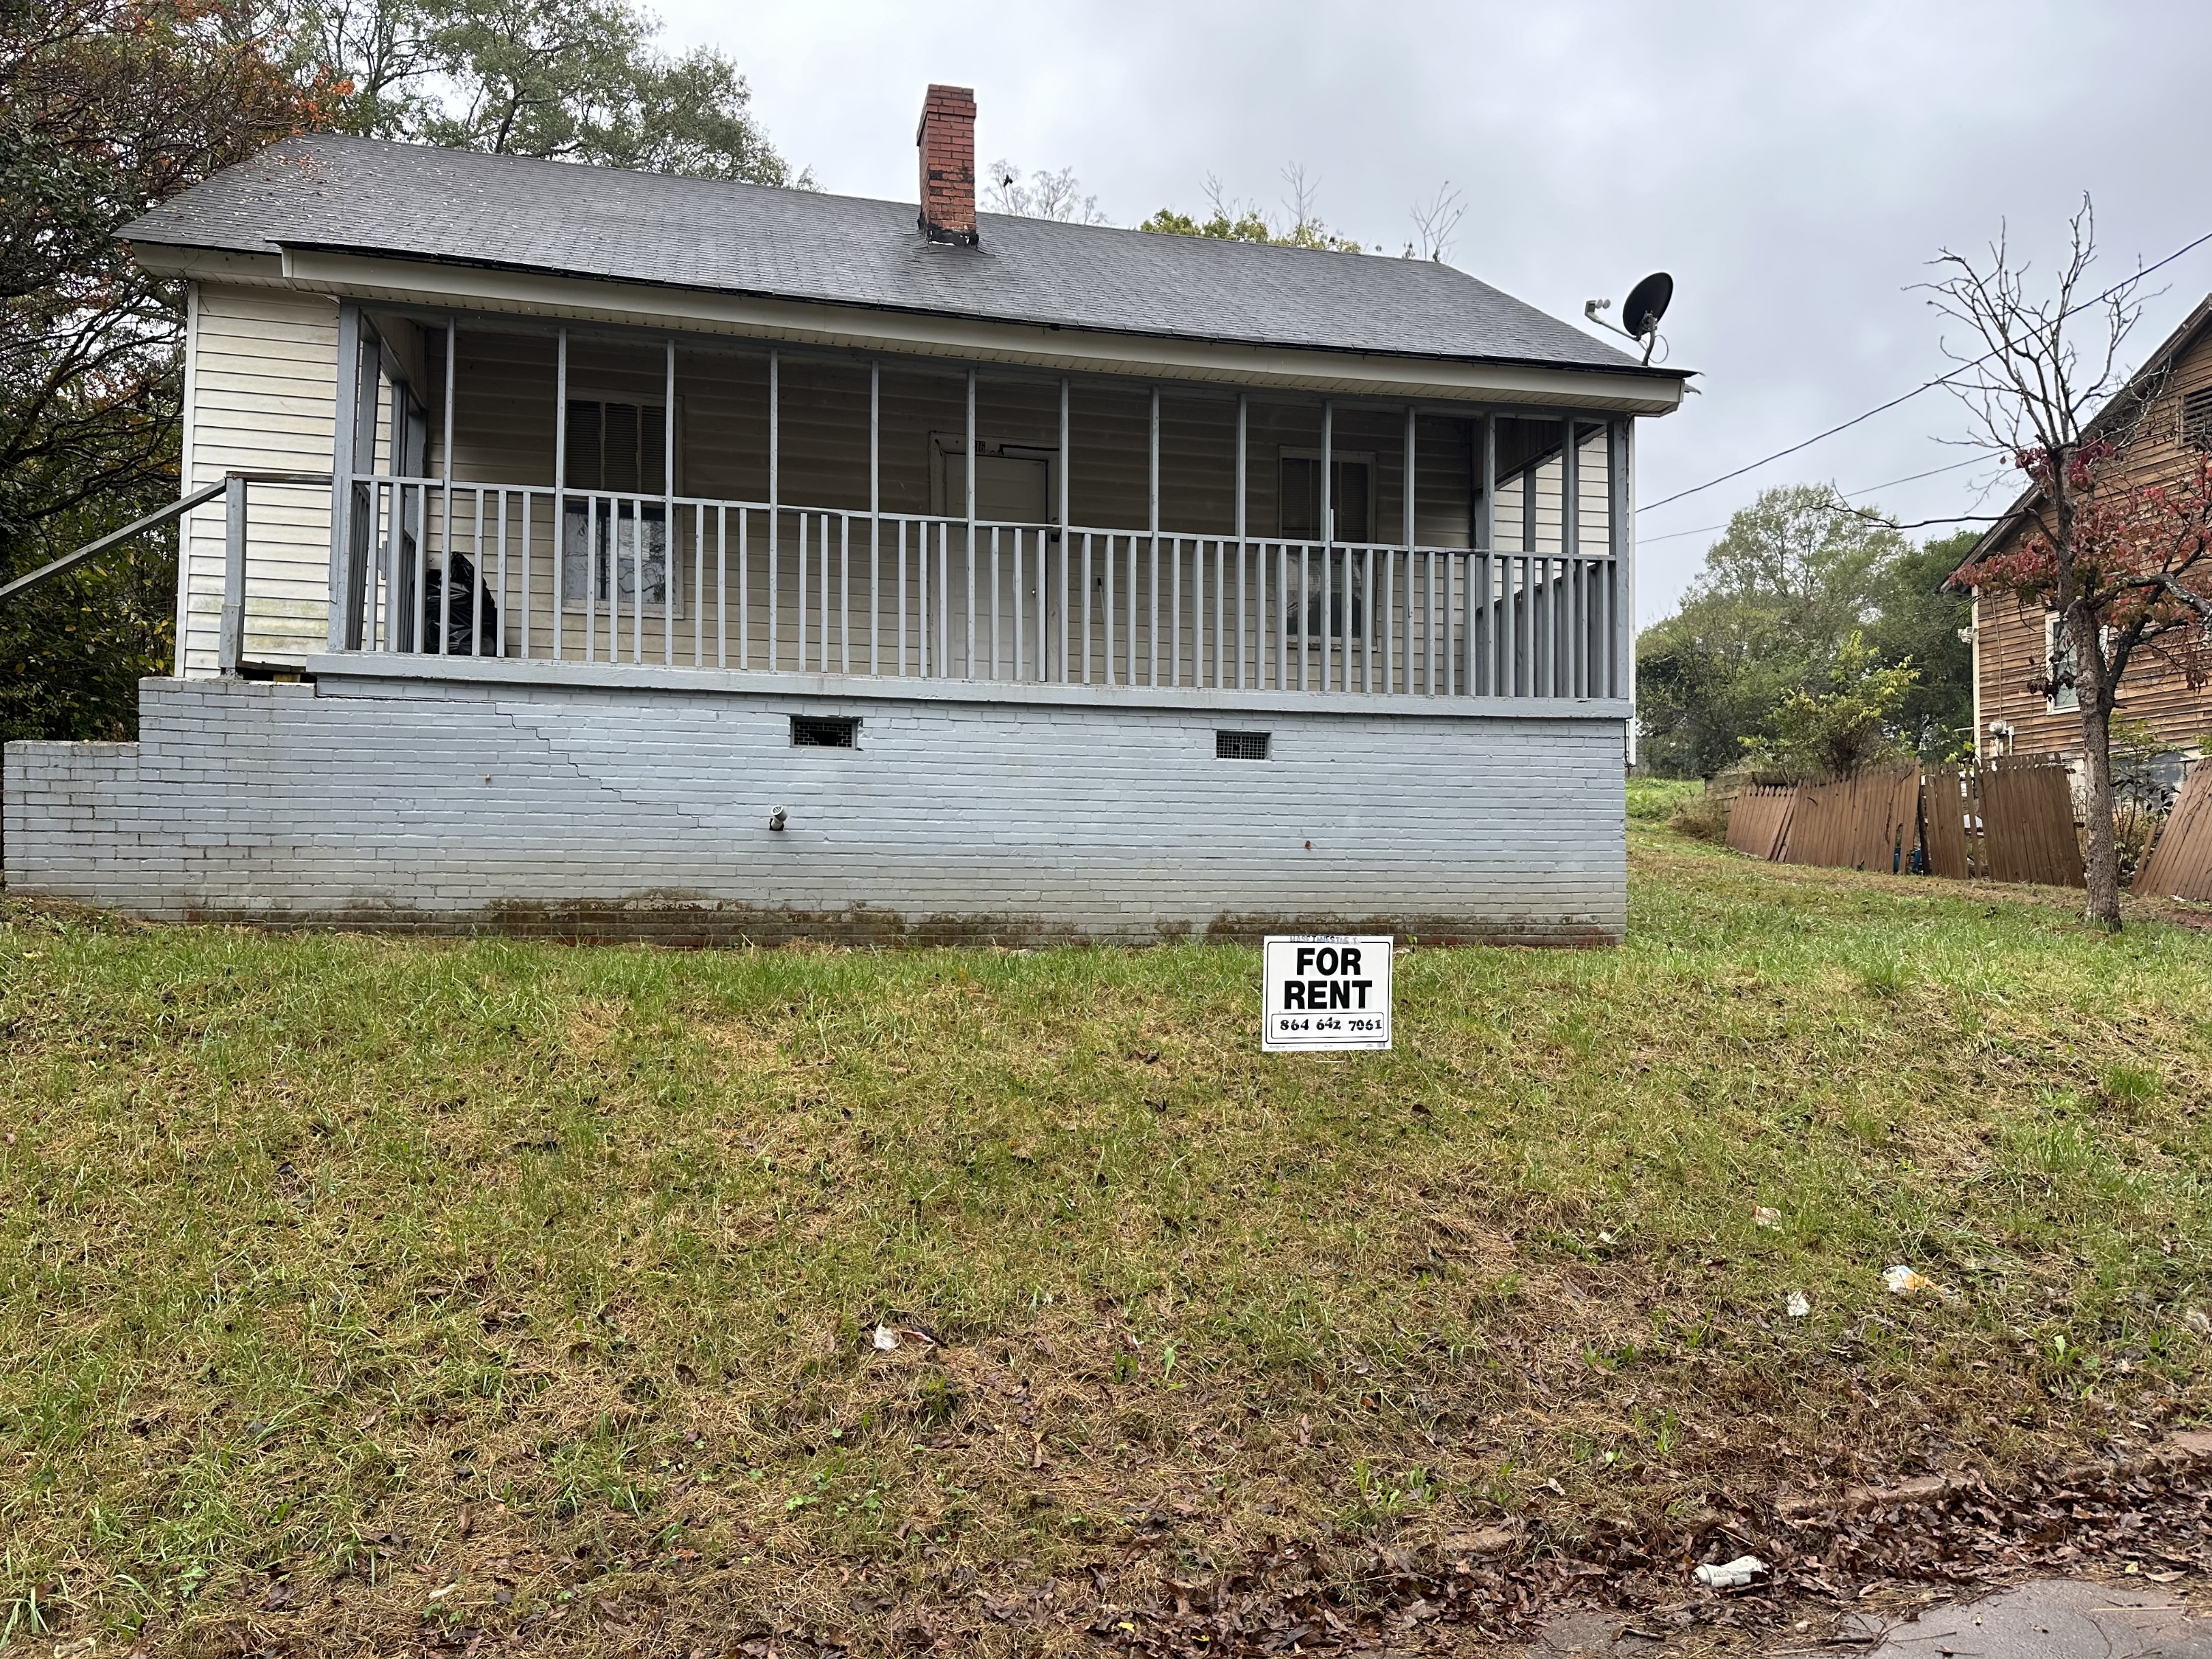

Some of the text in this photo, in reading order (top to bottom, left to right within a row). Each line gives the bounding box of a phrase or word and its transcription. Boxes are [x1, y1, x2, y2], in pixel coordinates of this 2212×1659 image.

[1297, 947, 1361, 975] FOR
[1284, 981, 1372, 1009] RENT
[1280, 1017, 1382, 1031] 864 642 7061
